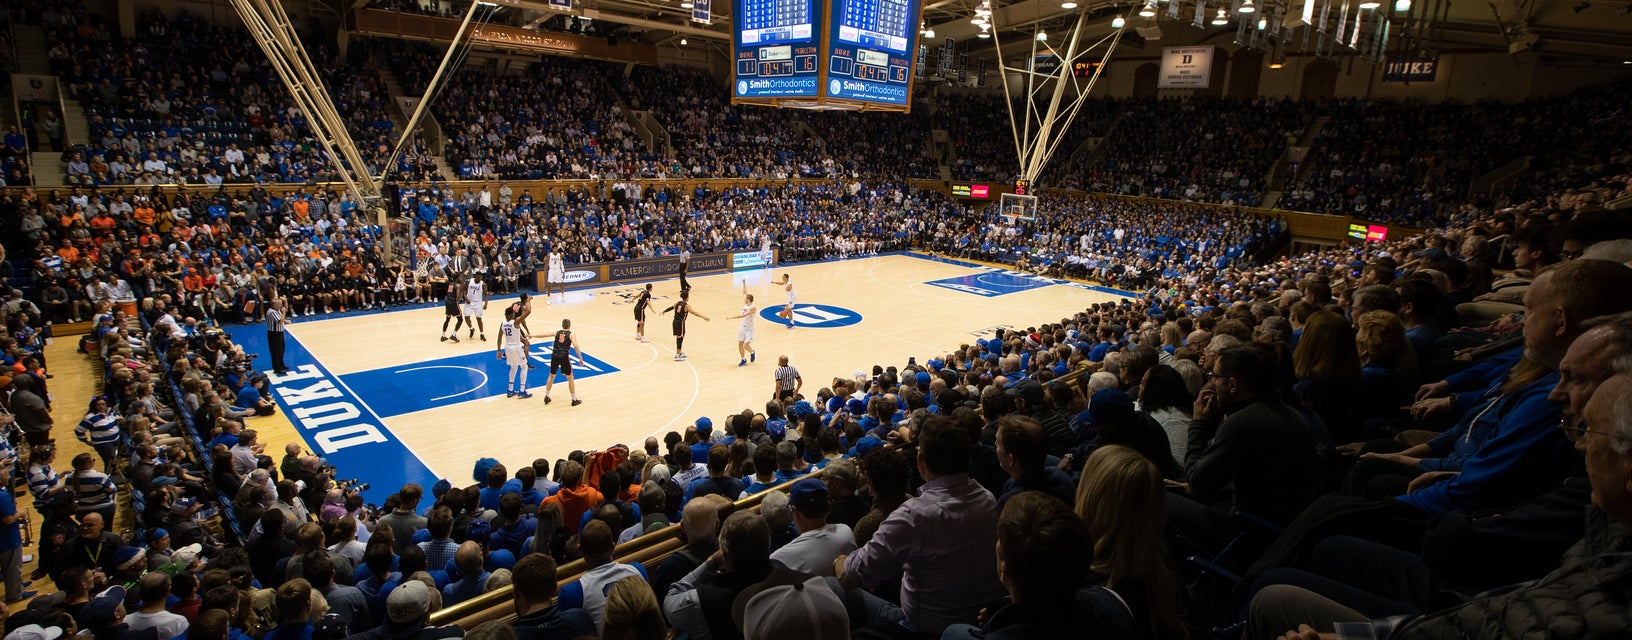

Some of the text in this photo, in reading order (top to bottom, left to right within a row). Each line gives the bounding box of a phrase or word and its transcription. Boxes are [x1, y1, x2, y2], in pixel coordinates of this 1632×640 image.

[746, 60, 754, 72] 11
[804, 57, 812, 70] 16
[897, 68, 904, 80] 16
[750, 79, 815, 89] SmithOrthodontics
[844, 81, 905, 97] SmithOrthodontics
[1015, 186, 1025, 195] 26
[613, 264, 654, 277] CAMERON
[692, 258, 724, 269] STADIUM
[504, 328, 512, 336] 12
[263, 364, 388, 454] DUKE
